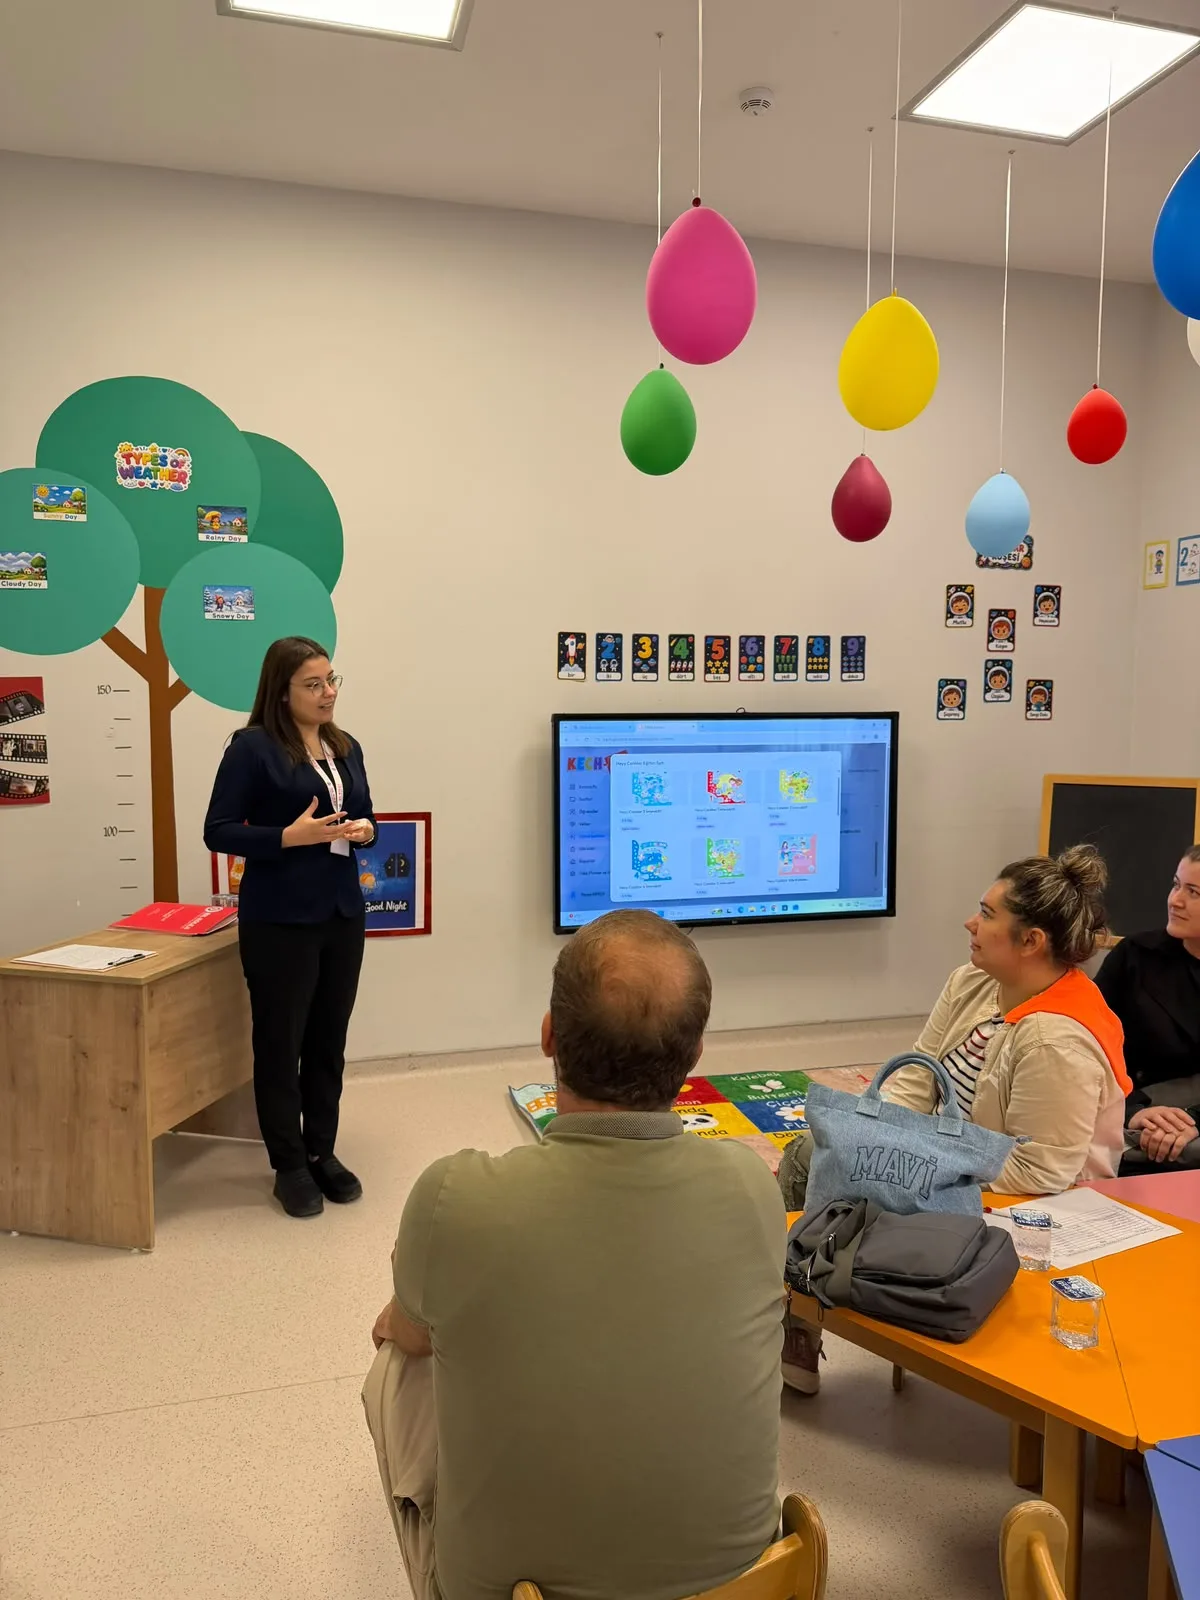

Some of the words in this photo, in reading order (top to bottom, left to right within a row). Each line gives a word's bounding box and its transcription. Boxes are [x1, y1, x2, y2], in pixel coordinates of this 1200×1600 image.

[121, 452, 168, 467] TYPES
[169, 458, 186, 469] OF
[118, 464, 188, 484] WEATHER
[1180, 547, 1189, 566] 2
[1, 580, 26, 588] Cloudy
[601, 640, 615, 659] 2
[637, 636, 653, 659] 3
[673, 637, 689, 660] 4
[711, 638, 725, 660] 5
[745, 637, 758, 655] 6
[780, 637, 792, 655] 7
[812, 637, 824, 656] 8
[847, 637, 859, 655] 9
[97, 684, 112, 695] 150
[103, 825, 118, 837] 100
[364, 901, 385, 913] Good
[385, 900, 408, 913] Night
[731, 1071, 782, 1082] Kelebek
[783, 1122, 810, 1130] Flo
[850, 1146, 938, 1201] MAVİ
